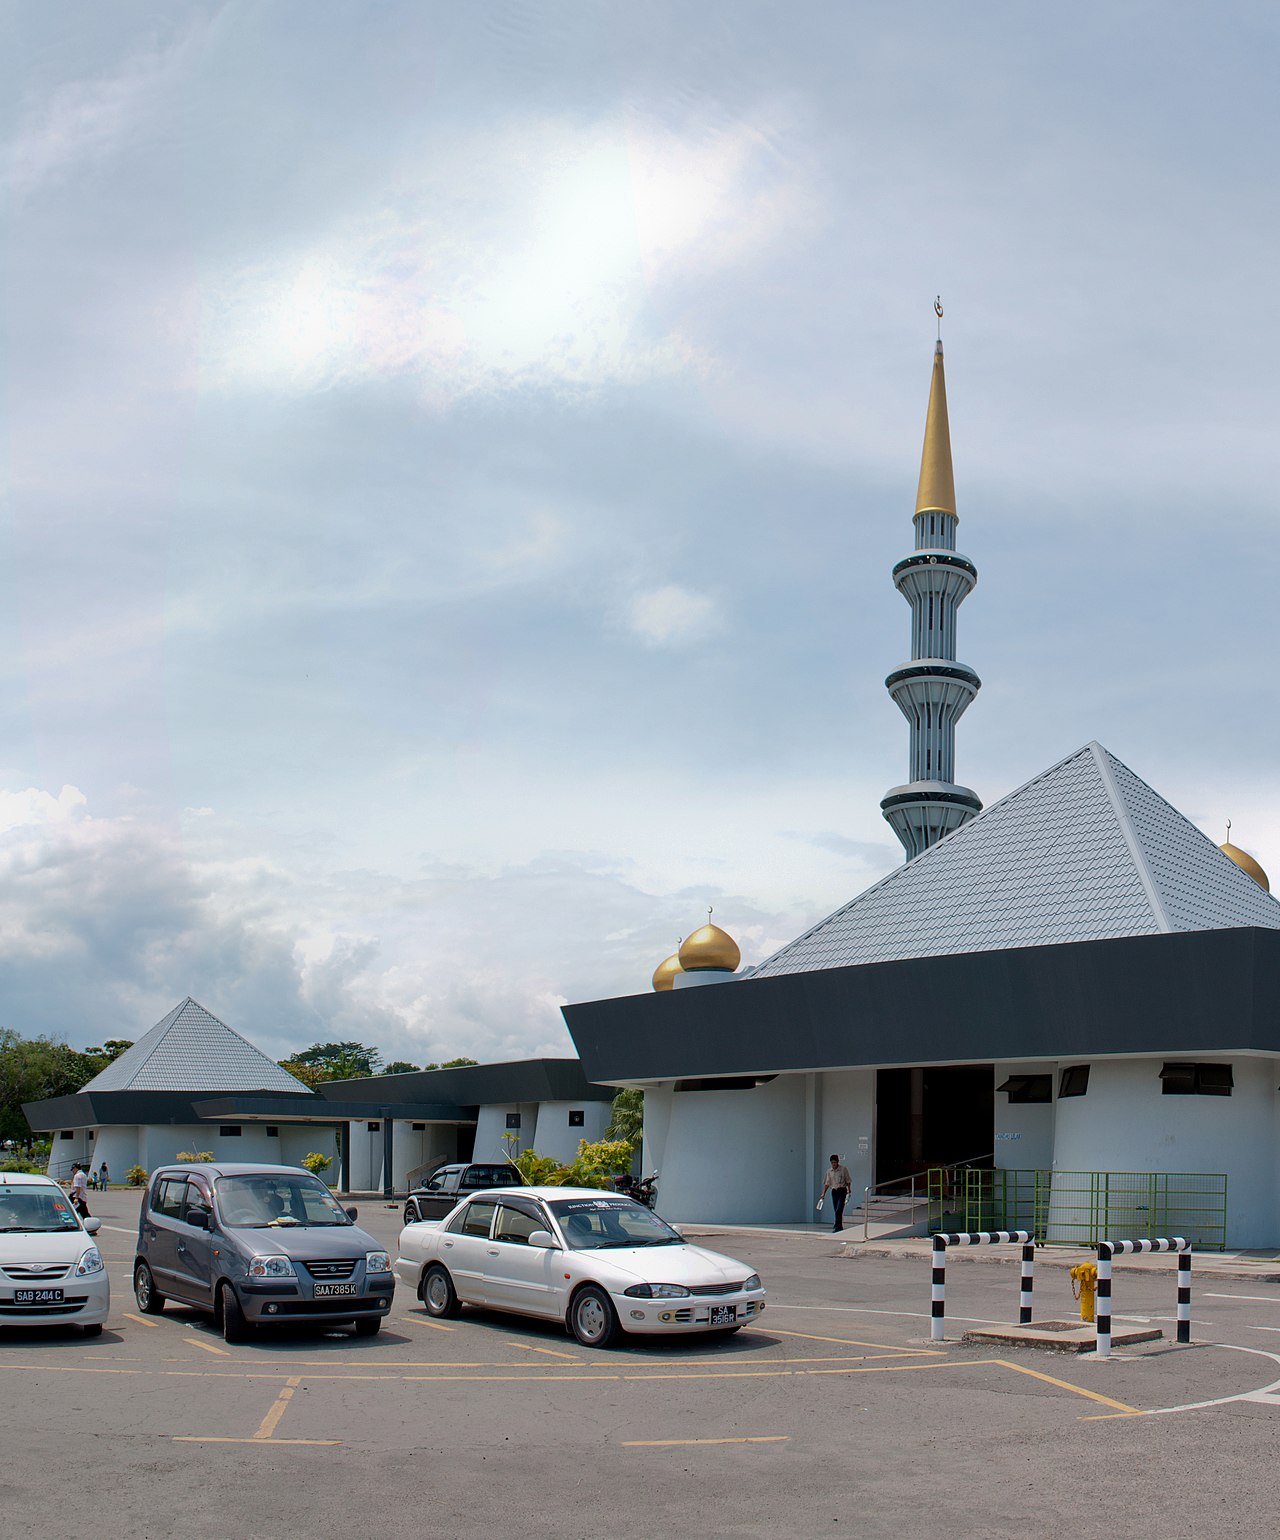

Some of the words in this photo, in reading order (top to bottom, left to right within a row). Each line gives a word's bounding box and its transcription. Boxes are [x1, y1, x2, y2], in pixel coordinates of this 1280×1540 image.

[315, 1285, 356, 1295] SAA7385K
[17, 1291, 34, 1301] SAB
[35, 1290, 54, 1300] 2414
[55, 1290, 61, 1299] C
[718, 1306, 728, 1315] SA
[712, 1313, 735, 1324] 3516R
